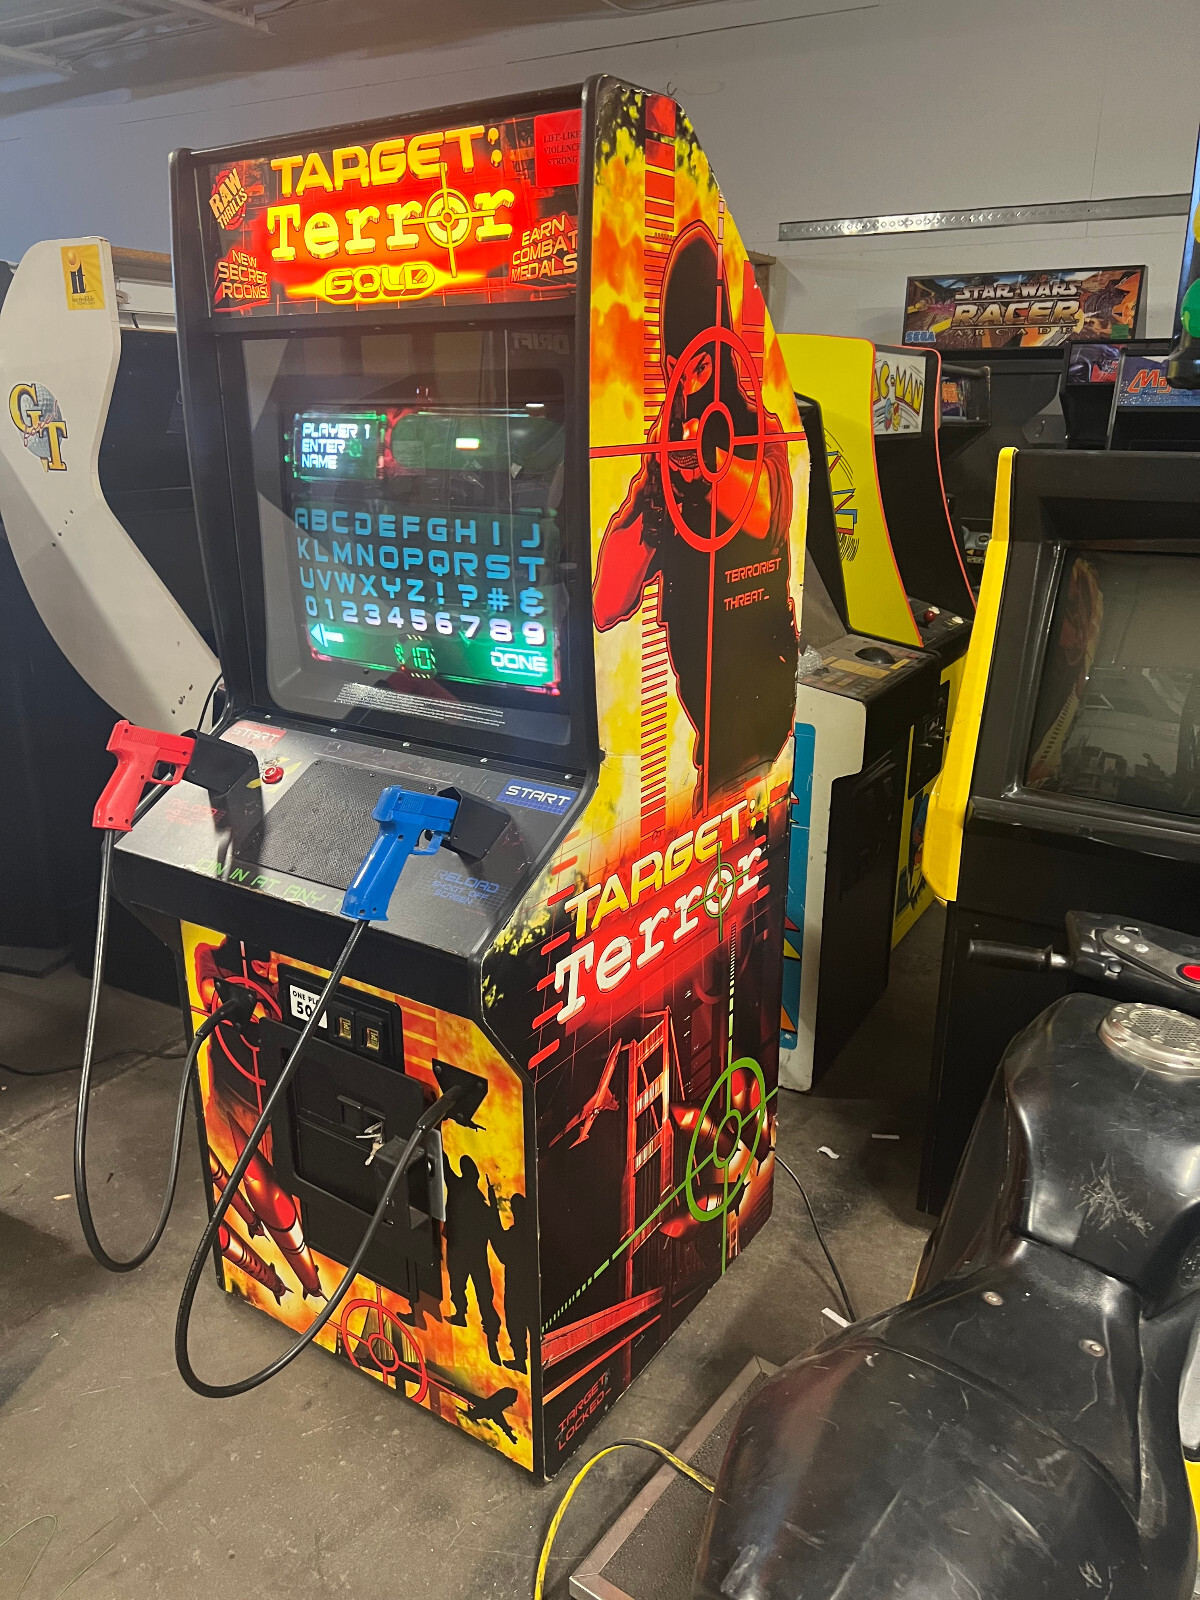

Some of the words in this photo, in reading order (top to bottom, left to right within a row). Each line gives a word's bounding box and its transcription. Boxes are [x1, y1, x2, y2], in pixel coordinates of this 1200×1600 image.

[271, 125, 502, 197] TARGET:
[547, 156, 578, 166] STRONG
[209, 168, 241, 219] RAW
[217, 187, 248, 229] THRILLS
[267, 188, 515, 262] Terror
[522, 214, 565, 247] EARN
[231, 249, 257, 268] NEW
[512, 230, 578, 266] COMBAT
[217, 261, 267, 285] SECRET
[511, 253, 578, 283] MEDALS
[324, 263, 436, 299] GOLD
[955, 284, 1014, 300] STAR
[1019, 281, 1083, 298] WARS
[952, 301, 1081, 326] RACER
[905, 330, 937, 344] SEGA
[953, 326, 1075, 337] ARCADE
[302, 423, 358, 438] PLAYER
[364, 424, 371, 439] 1
[302, 438, 345, 454] ENTER
[301, 454, 338, 469] NAME
[725, 558, 781, 583] TERRORIST
[490, 650, 548, 672] DONE
[231, 727, 280, 742] START
[505, 785, 571, 806] START
[434, 869, 500, 893] RELOAD
[564, 799, 757, 940] TARGET:
[229, 867, 249, 881] IN
[251, 874, 280, 890] AT
[282, 885, 326, 903] ANY
[431, 880, 465, 893] SHOOT
[468, 890, 488, 900] OFF
[433, 889, 474, 905] SCREEN
[554, 847, 762, 1025] Terror
[293, 990, 305, 1001] ONE
[558, 1371, 608, 1430] TARGET
